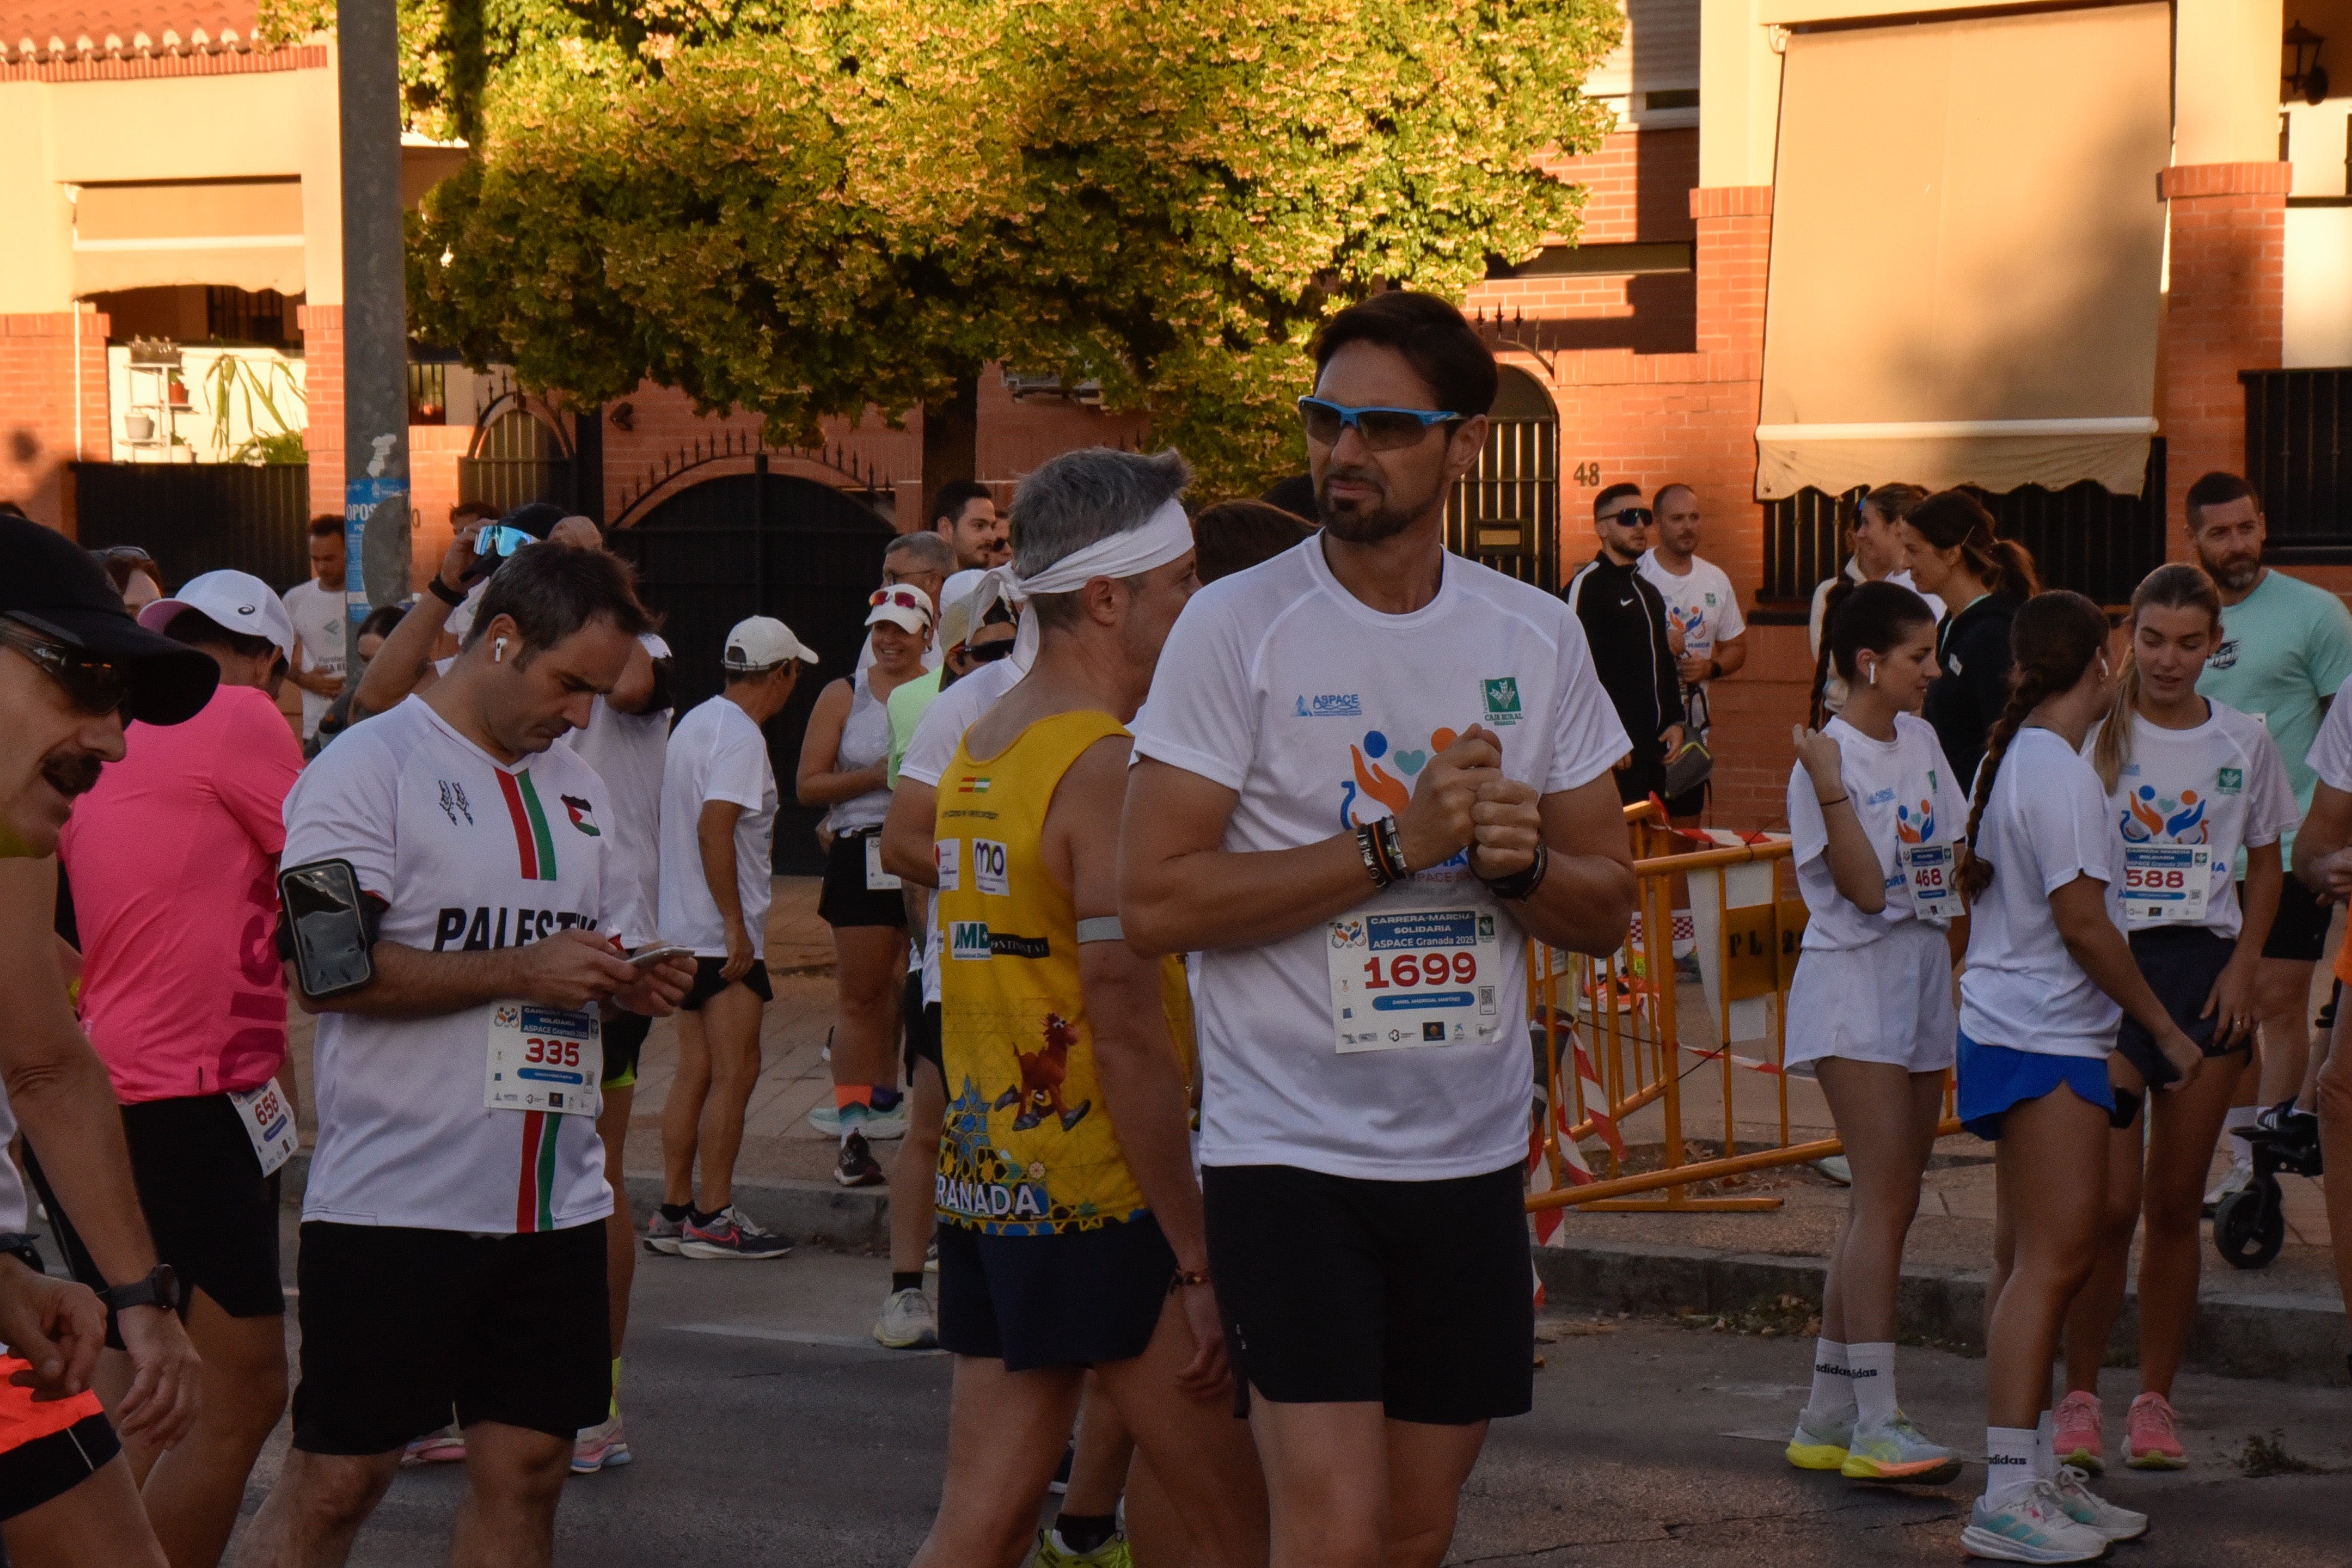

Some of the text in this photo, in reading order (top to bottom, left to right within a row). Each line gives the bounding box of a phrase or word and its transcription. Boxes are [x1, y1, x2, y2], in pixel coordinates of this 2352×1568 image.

[1573, 462, 1600, 487] 48
[1313, 694, 1359, 708] ASPACE
[1915, 868, 1942, 887] 468
[2126, 869, 2184, 888] 588
[1370, 913, 1471, 924] CARRERA-MARCHA
[1394, 925, 1452, 934] SOLIDARIA
[1373, 938, 1414, 949] ASPACE
[1416, 936, 1454, 946] Granada
[1456, 936, 1475, 944] 2025
[1364, 951, 1477, 990] 1699
[523, 1024, 552, 1034] ASPACE
[525, 1037, 580, 1067] 335
[255, 1090, 279, 1126] 658
[1816, 1364, 1851, 1376] adidas
